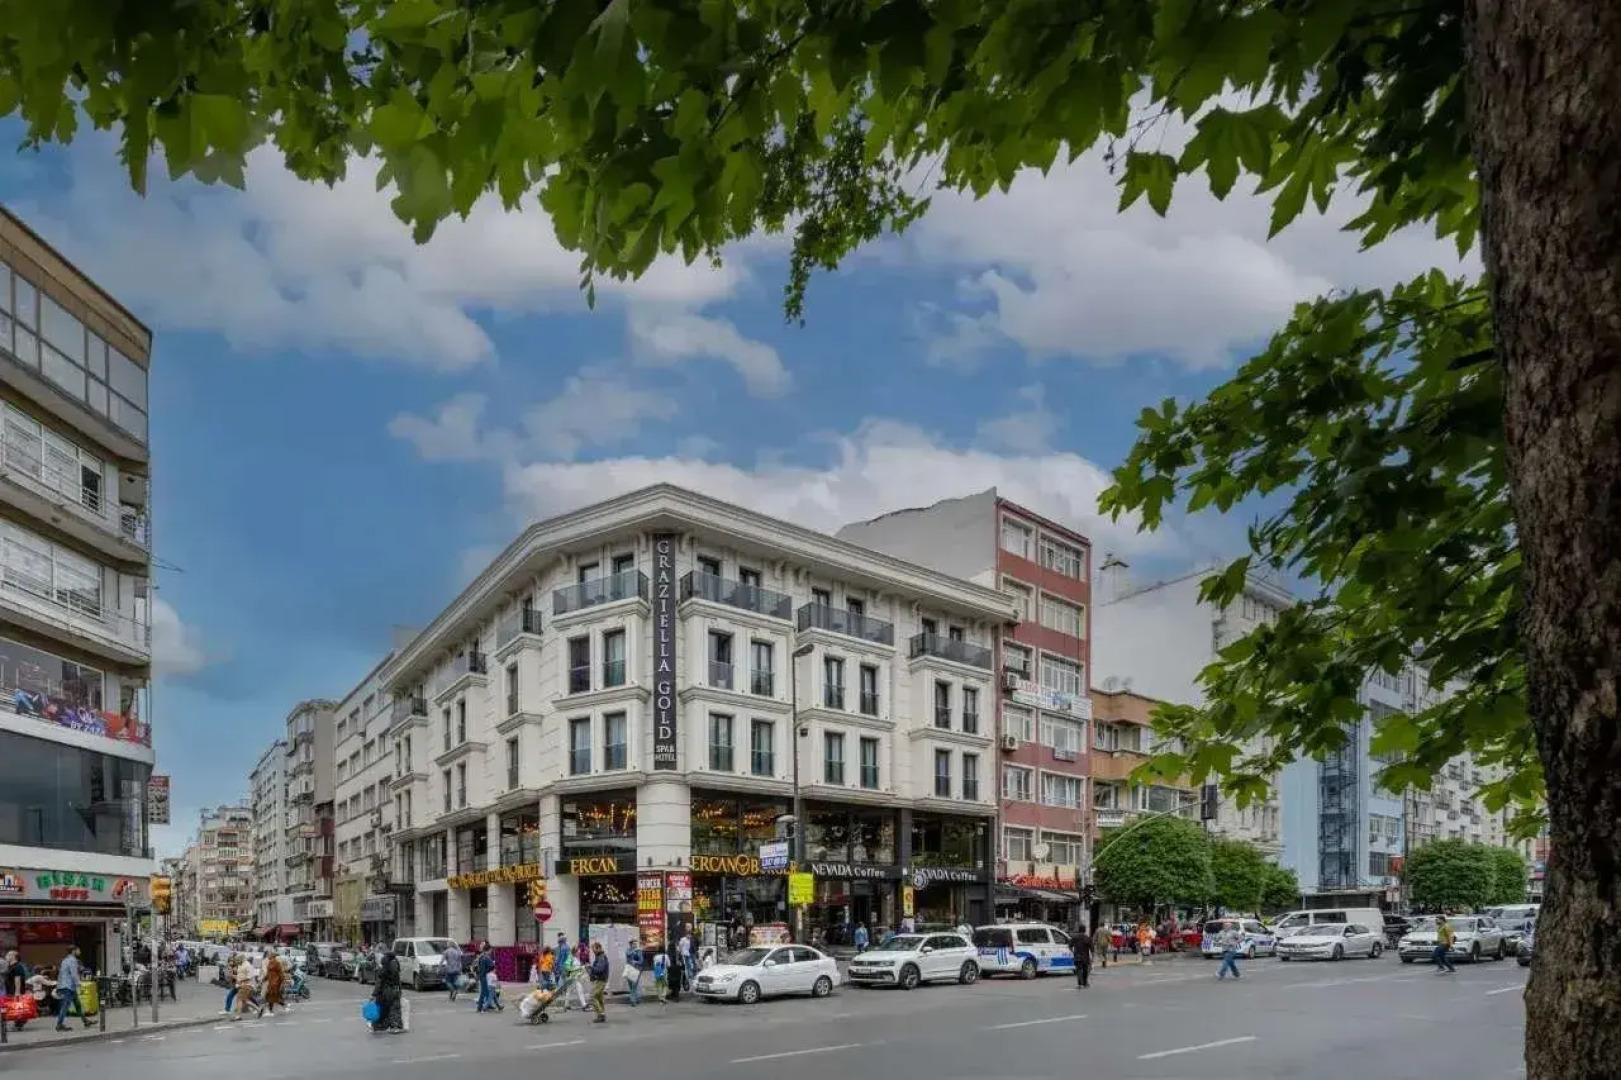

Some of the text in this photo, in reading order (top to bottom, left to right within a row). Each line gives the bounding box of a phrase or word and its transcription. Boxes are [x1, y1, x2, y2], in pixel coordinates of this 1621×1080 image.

[657, 540, 672, 740] GRAZIELLA GOLD
[570, 856, 618, 874] ERCAN
[691, 855, 737, 872] ERCAN
[812, 862, 886, 879] NEVADA Coffee
[950, 870, 978, 882] Coffee
